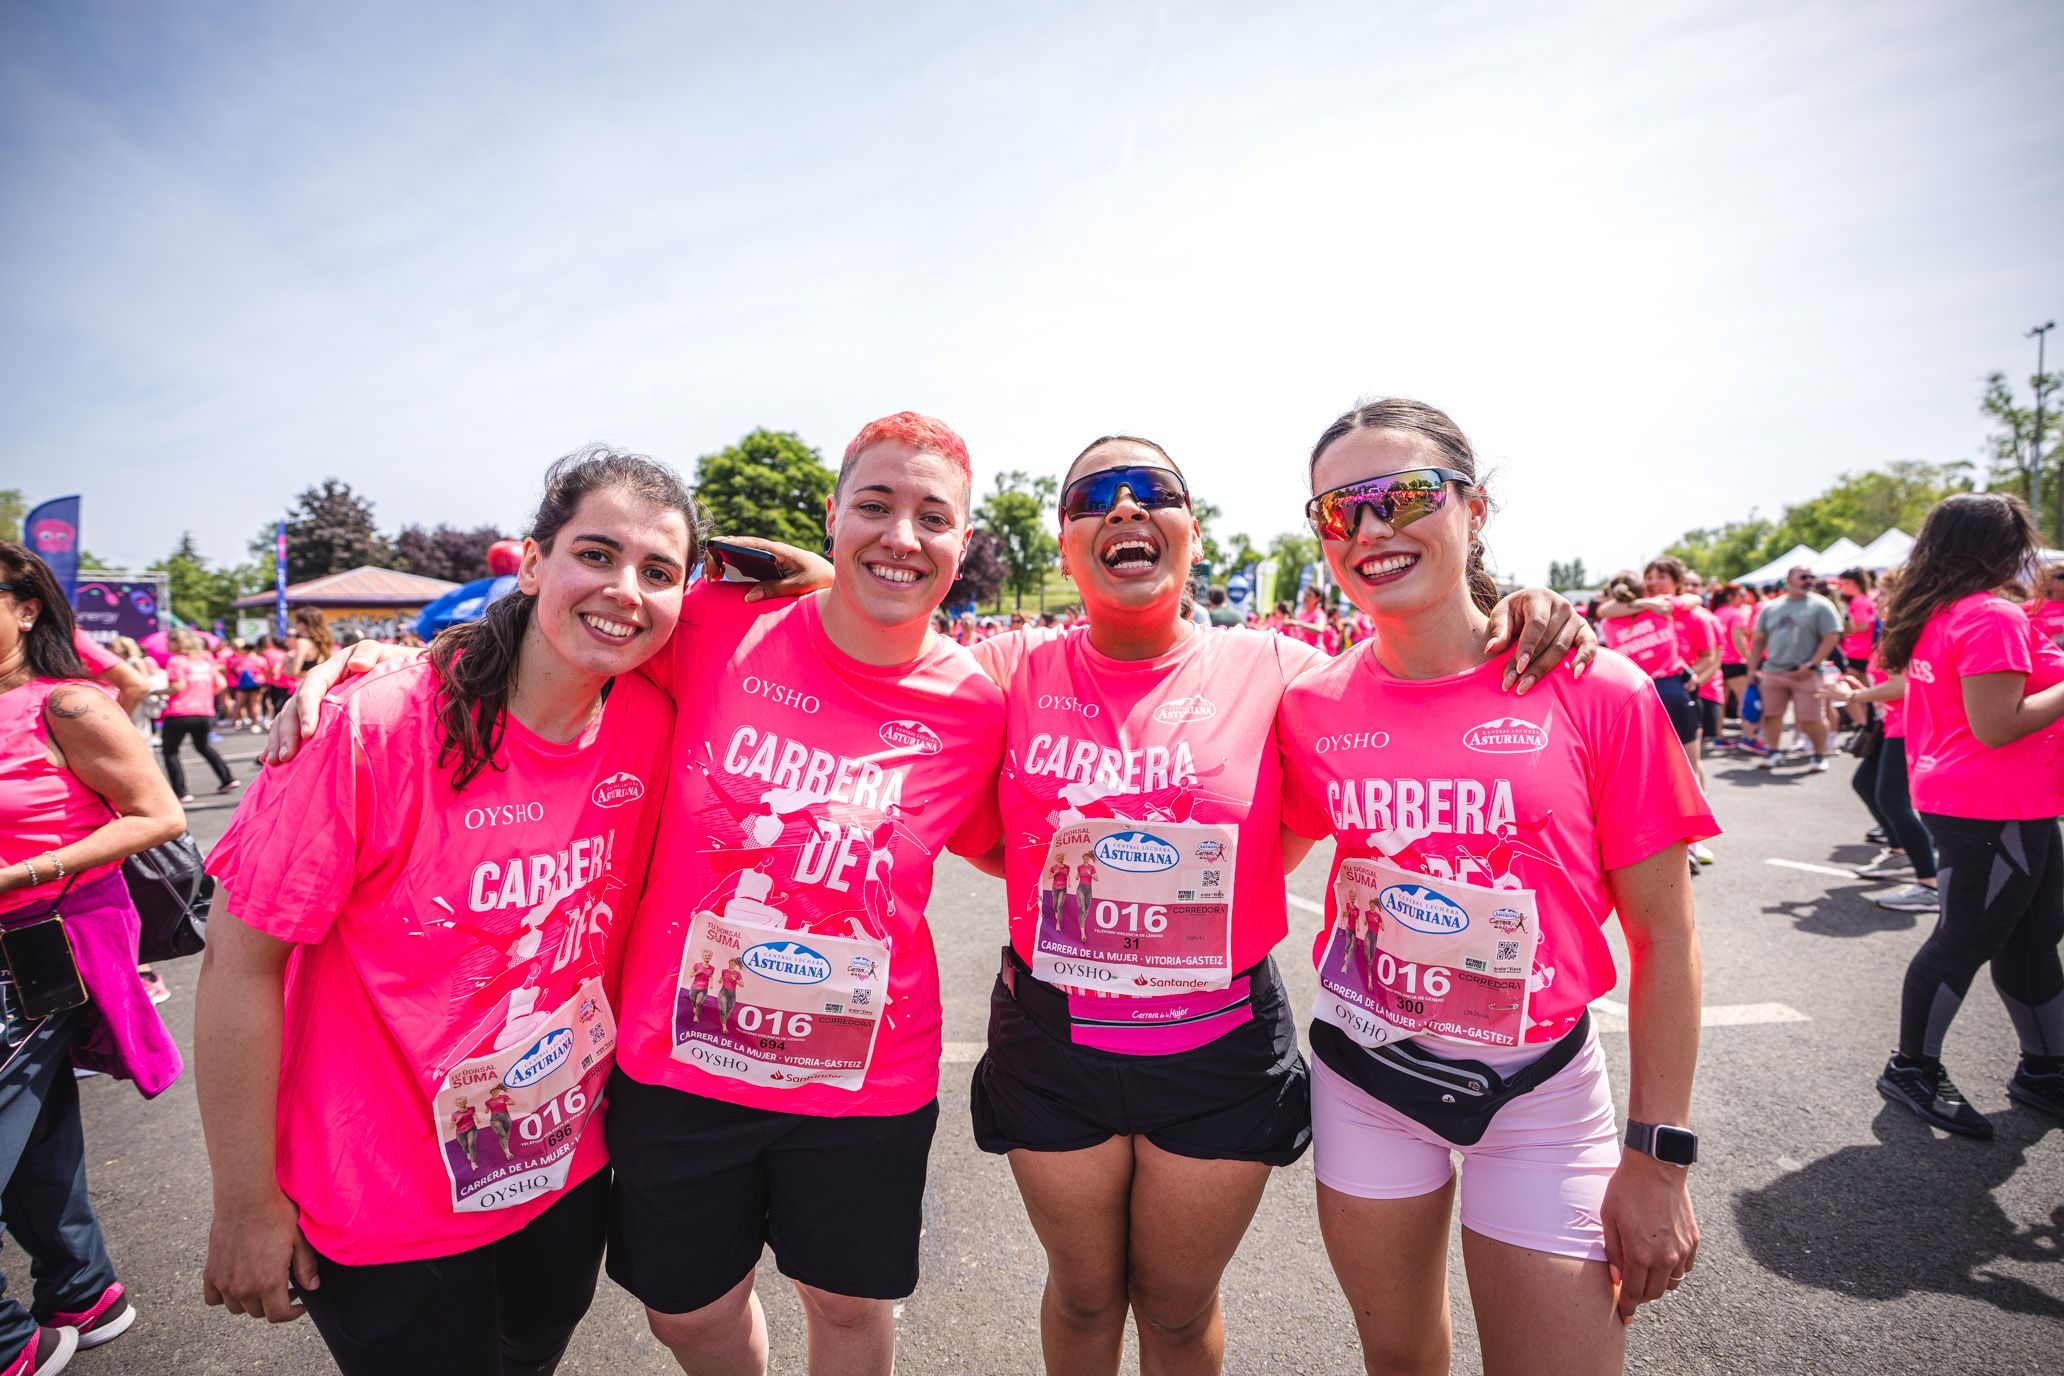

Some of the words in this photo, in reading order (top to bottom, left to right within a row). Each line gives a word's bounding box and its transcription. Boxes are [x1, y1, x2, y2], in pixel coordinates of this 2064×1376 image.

[743, 676, 820, 714] OYSHO
[1038, 694, 1099, 718] OYSHO
[883, 725, 937, 752] ASTURIANA
[1315, 731, 1390, 754] OYSHO
[1469, 732, 1542, 746] ASTURIANA
[722, 724, 903, 816] CARRERA
[1024, 733, 1198, 794] CARRERA
[465, 802, 544, 829] OYSHO
[1326, 778, 1517, 835] CARRERA
[1055, 834, 1091, 848] SUMA
[1063, 828, 1091, 839] DORSAL
[1100, 843, 1173, 865] ASTURIANA
[1113, 843, 1141, 851] CENTRAL
[1142, 845, 1171, 853] LECHERA
[1346, 872, 1378, 890] SUMA
[1353, 866, 1377, 879] DORSAL
[1173, 906, 1225, 914] CORREDORA
[1385, 893, 1461, 929] ASTURIANA
[1398, 893, 1423, 907] CENTRAL
[1426, 903, 1459, 915] LECHERA
[1095, 901, 1168, 933] 016
[706, 929, 740, 950] SUMA
[707, 922, 717, 931] TU
[716, 924, 742, 939] DORSAL
[1041, 940, 1078, 956] CARRERA
[1080, 948, 1092, 958] DE
[1093, 950, 1105, 959] LA
[1107, 952, 1138, 963] MUJER
[1145, 955, 1223, 965] VITORIA-GASTEIZ
[1124, 937, 1139, 949] 31
[748, 951, 824, 979] ASTURIANA
[763, 951, 792, 962] CENTRAL
[794, 957, 824, 966] LECHERA
[1054, 961, 1112, 982] OYSHO
[1150, 977, 1208, 988] Santander
[1377, 953, 1452, 997] 016
[1458, 973, 1521, 990] CORREDORA
[1132, 1010, 1159, 1019] Carrera
[1169, 1006, 1189, 1020] Mujer
[1323, 979, 1362, 1004] CARRERA
[1364, 999, 1375, 1011] DE
[1375, 1005, 1385, 1016] LA
[1385, 1009, 1416, 1029] MUJER
[1396, 996, 1424, 1015] 300
[737, 1006, 813, 1037] 016
[818, 1016, 872, 1028] CORREDORA
[1335, 1004, 1388, 1043] OYSHO
[680, 1031, 719, 1045] CARRERA
[720, 1037, 733, 1048] DE
[733, 1041, 745, 1053] LA
[747, 1046, 777, 1061] MUJER
[784, 1054, 862, 1069] VITORIA-GASTEIZ
[760, 1039, 785, 1051] 694
[462, 1064, 496, 1076] DORSAL
[691, 1046, 748, 1073] OYSHO
[453, 1071, 498, 1089] SUMA
[786, 1071, 842, 1083] Santander
[519, 1084, 586, 1140] 016
[548, 1124, 572, 1147] 696
[460, 1170, 507, 1196] CARRERA
[509, 1163, 523, 1174] DE
[524, 1158, 538, 1170] LA
[540, 1143, 571, 1165] MUJER
[480, 1175, 548, 1208] OYSHO
